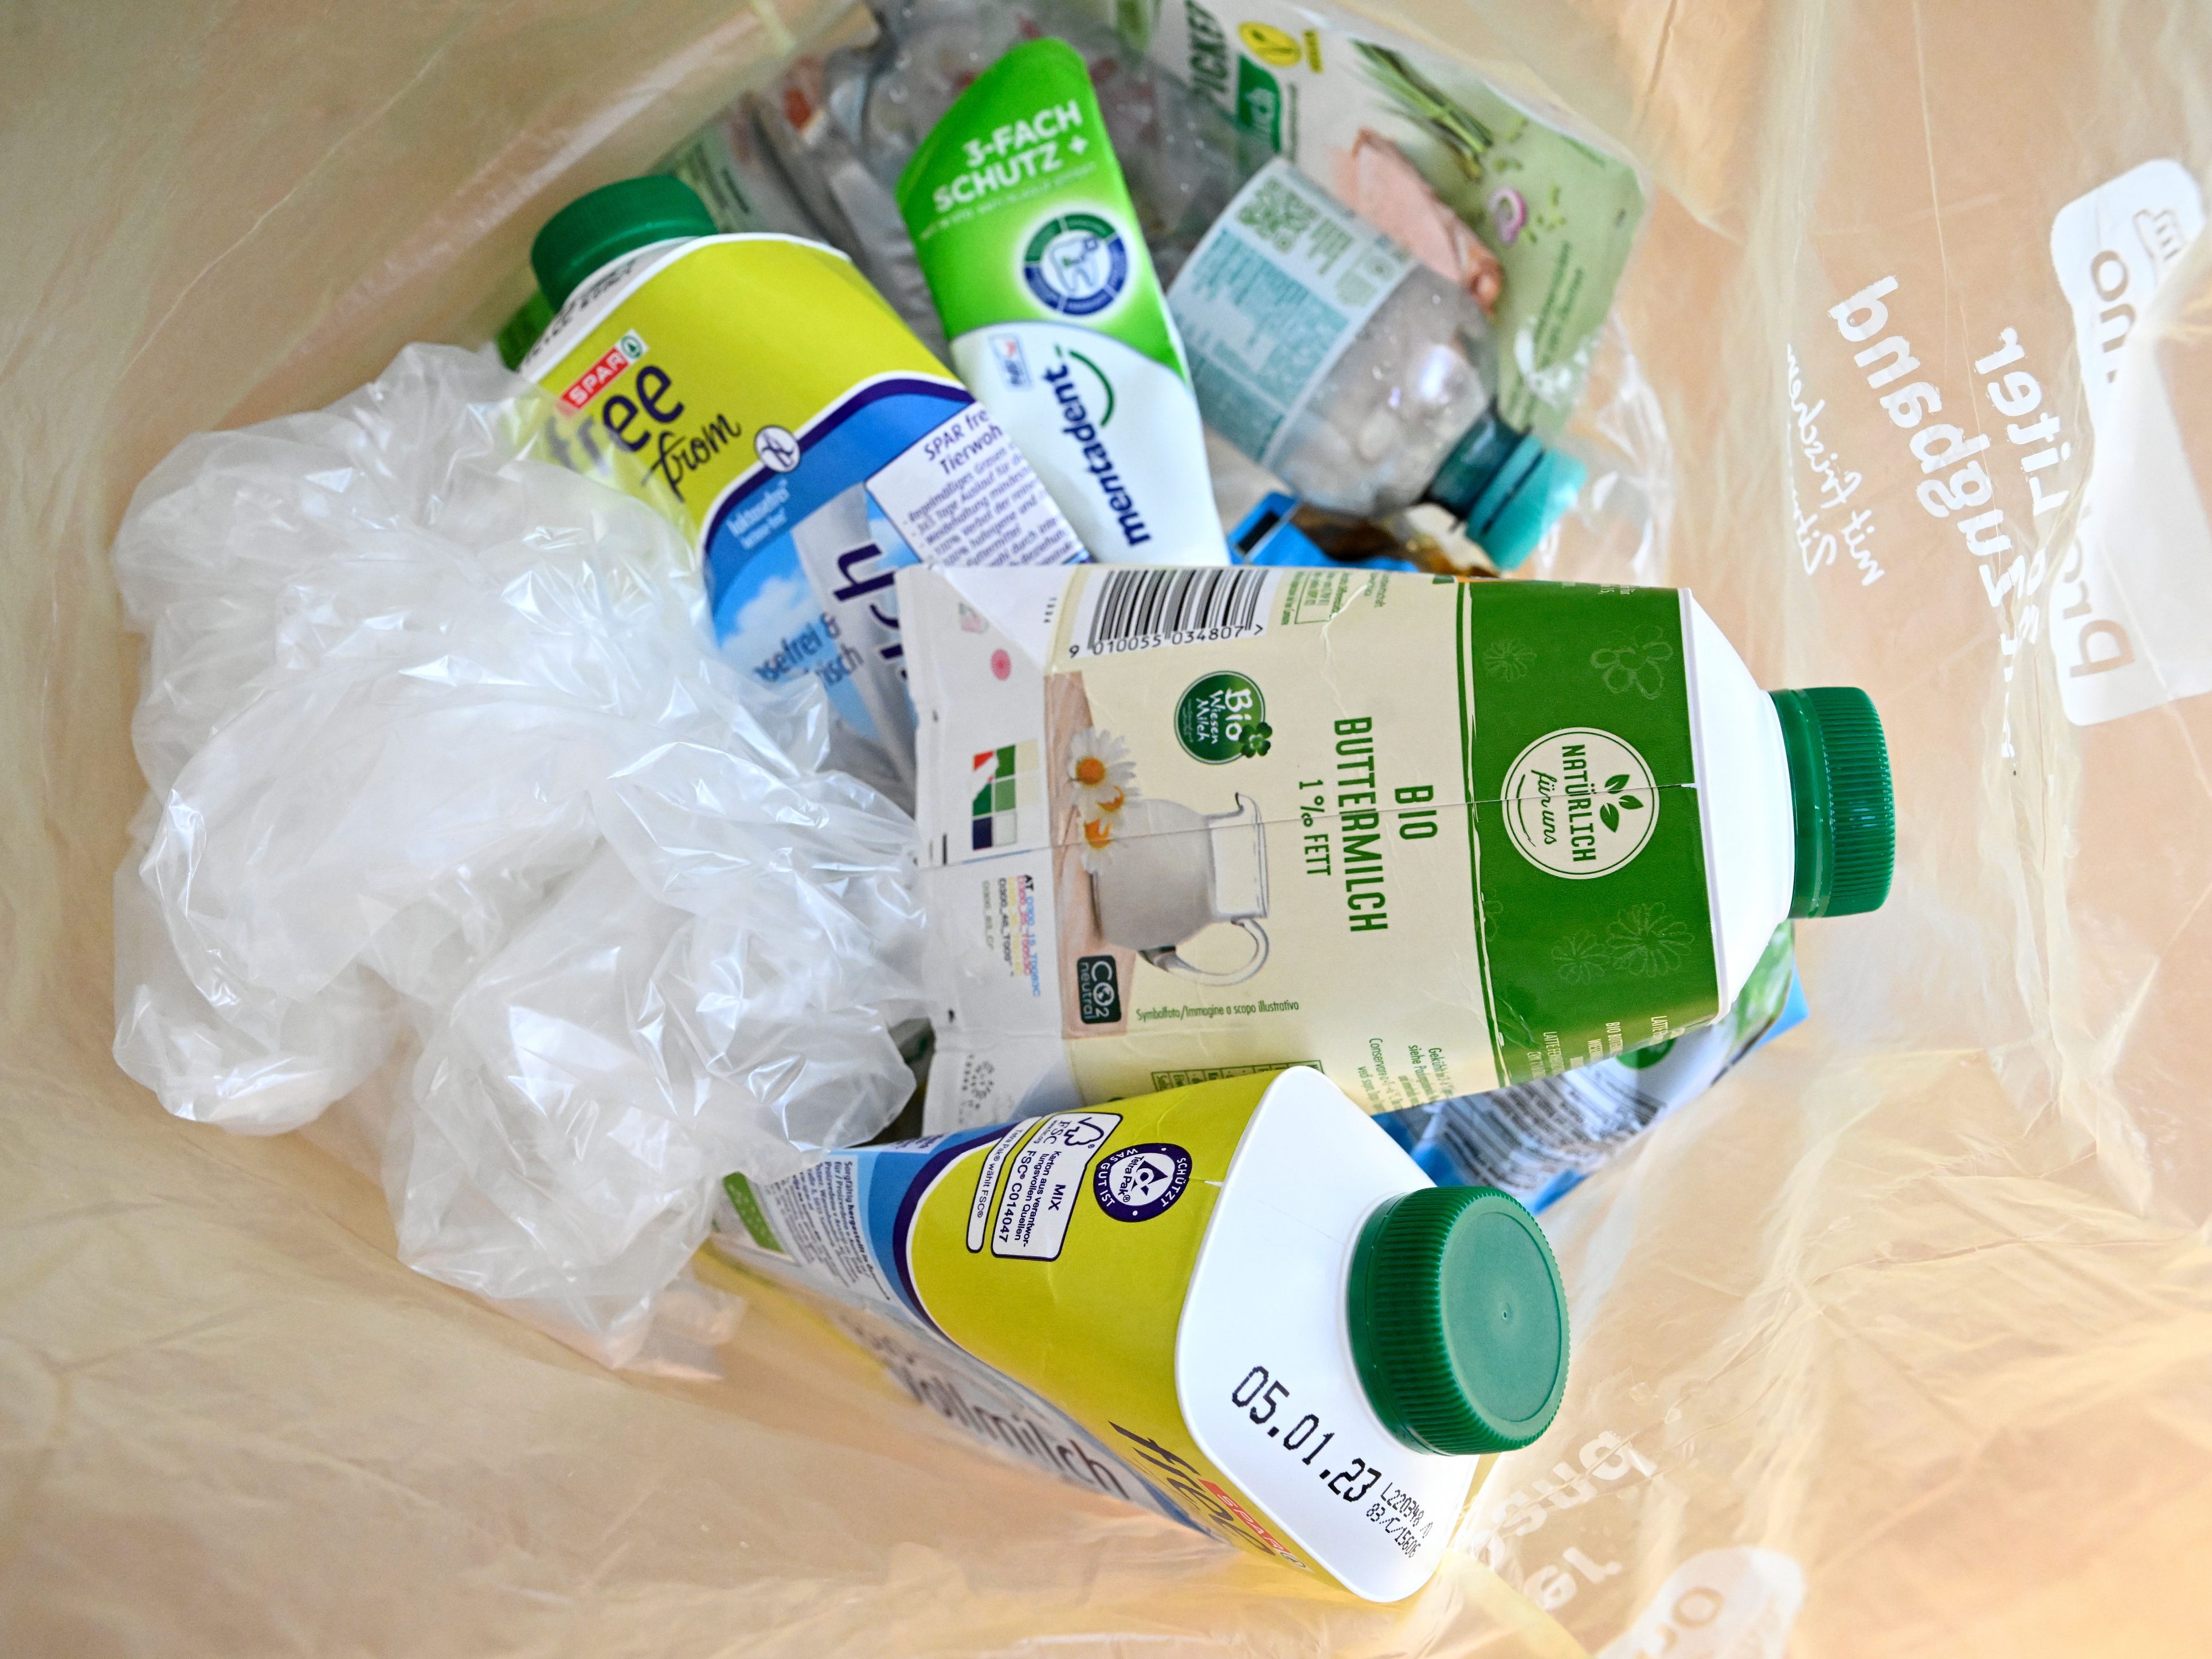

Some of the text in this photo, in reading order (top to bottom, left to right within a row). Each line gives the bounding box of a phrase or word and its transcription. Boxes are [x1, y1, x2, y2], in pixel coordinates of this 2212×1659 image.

[963, 100, 1083, 168] 3-FACH
[933, 141, 1064, 212] SCHUTZ
[569, 352, 627, 405] SPAR
[964, 409, 990, 431] fre
[641, 414, 742, 504] from
[939, 422, 1004, 475] Tierwoh
[1043, 364, 1152, 547] mentadent
[1070, 625, 1244, 659] 9 010055 034807
[1196, 697, 1212, 743] Milch
[1208, 690, 1227, 744] Wiesen
[1225, 688, 1253, 743] Bio
[1299, 779, 1332, 877] 1 % FETT
[1334, 716, 1389, 933] BUTTERMILCH
[1395, 784, 1439, 840] BIO
[1530, 769, 1558, 846] für uns
[1561, 744, 1597, 862] NATÜRLICH
[1079, 961, 1093, 1020] neutral
[1137, 1001, 1224, 1023] Symbolfoto/Immagine
[1233, 1003, 1256, 1016] scopo
[1258, 1000, 1299, 1014] illustrativo
[1408, 1044, 1420, 1065] siehe
[1606, 1022, 1621, 1033] BIO
[1005, 1128, 1024, 1145] Tetra
[1042, 1120, 1072, 1144] FSC
[982, 1162, 996, 1188] wählt
[1097, 1147, 1188, 1208] SCHÜTZT WAS GUT IST
[1125, 1155, 1145, 1173] Tetra
[999, 1182, 1023, 1243] C014047
[1014, 1153, 1050, 1241] tungsvollen Quellen
[1022, 1151, 1062, 1247] Karton aus verantwor-
[1048, 1183, 1066, 1211] MIX
[1231, 1365, 1383, 1503] 05.01.23
[1216, 1492, 1287, 1552] SPAR
